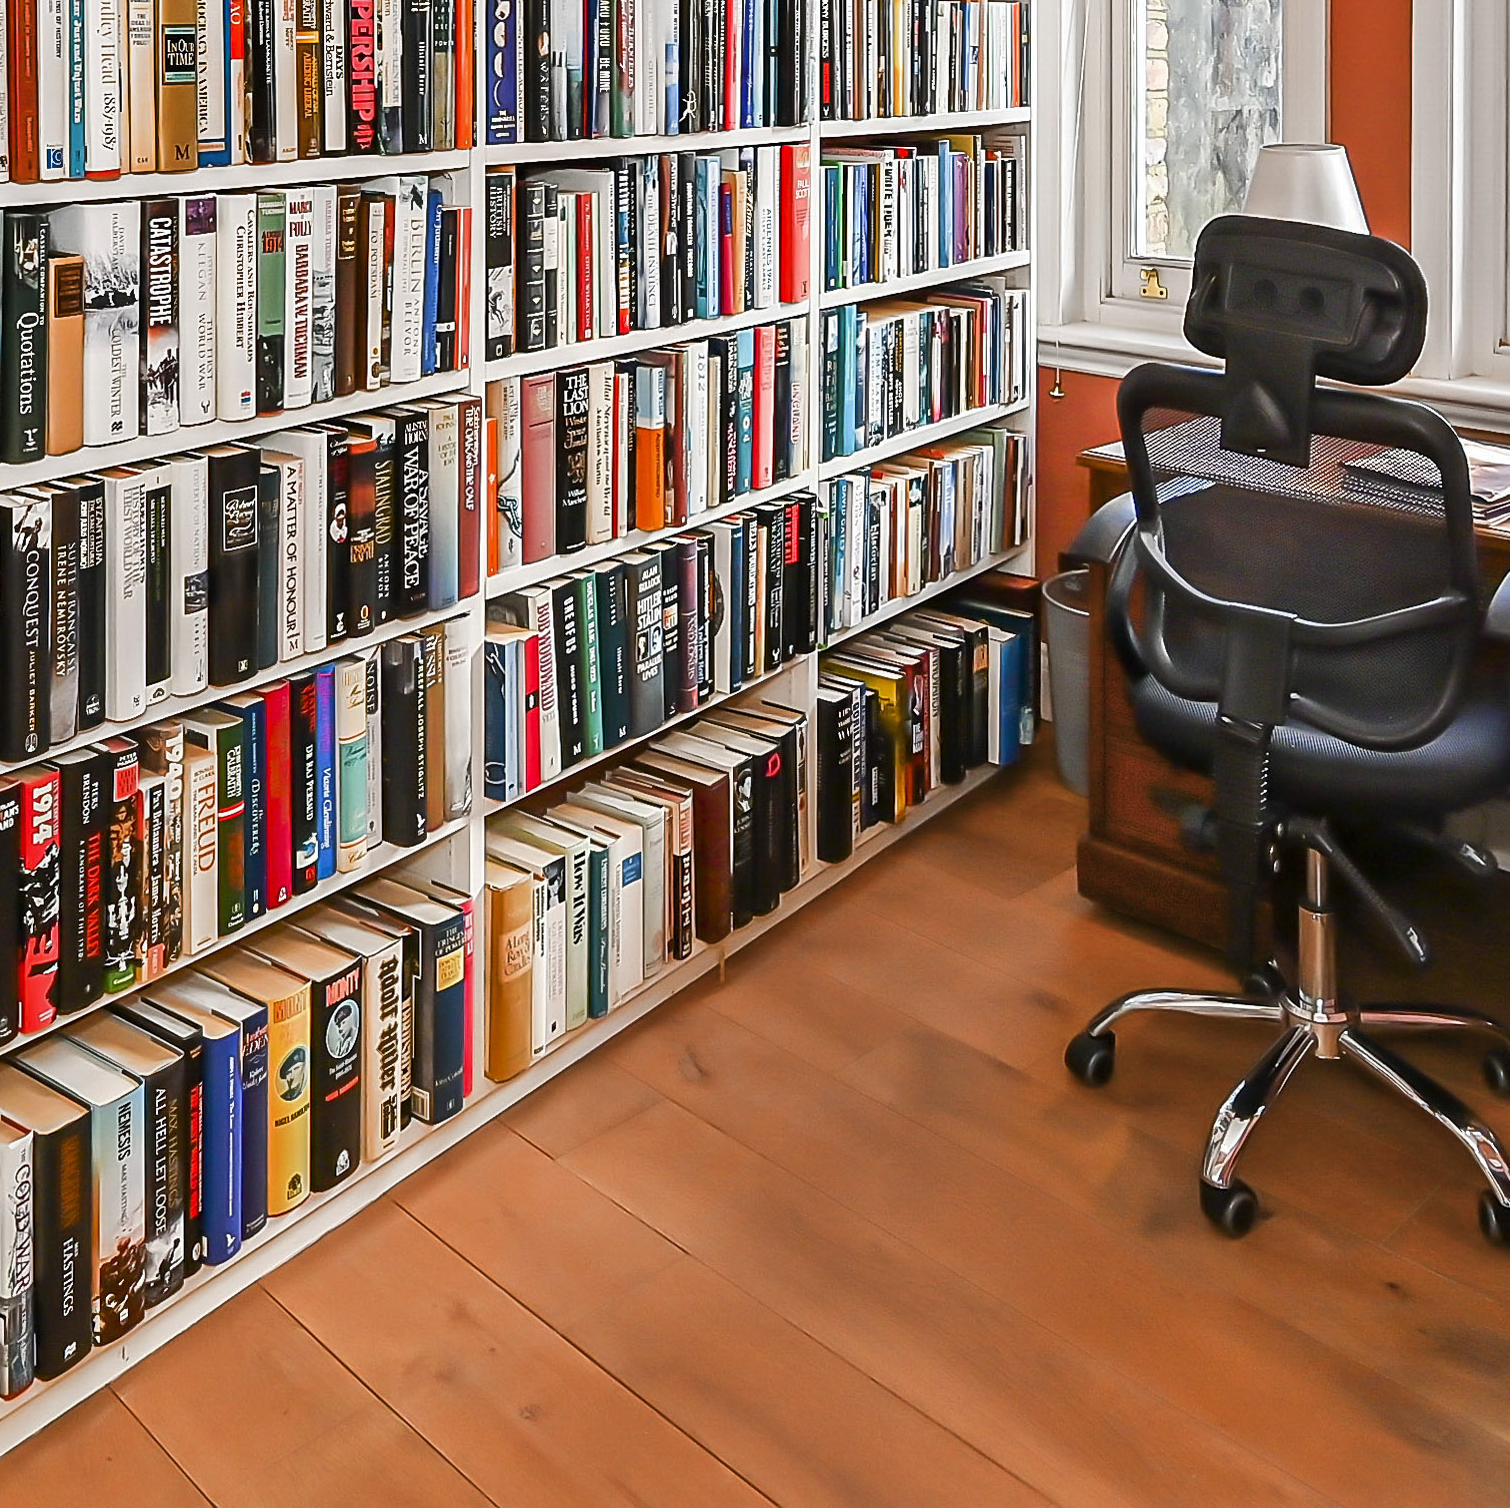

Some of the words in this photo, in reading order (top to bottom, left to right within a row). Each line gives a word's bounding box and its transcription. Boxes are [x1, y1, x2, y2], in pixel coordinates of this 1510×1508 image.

[149, 218, 172, 327] CATASTROPHE
[17, 313, 41, 416] Quotations
[563, 399, 588, 416] LION
[287, 467, 296, 477] A
[375, 460, 393, 544] STALINGRAD
[287, 481, 297, 540] MATTER
[286, 544, 297, 562] OF
[25, 550, 39, 647] CONQUEST
[286, 567, 297, 632] HONOUR
[32, 783, 53, 844] 1914
[198, 788, 216, 870] FREUD
[325, 969, 360, 1005] MONTY
[117, 1100, 131, 1161] NEMESIS
[156, 1089, 166, 1117] ALL
[156, 1120, 166, 1154] HELL
[156, 1158, 167, 1182] LET
[155, 1187, 167, 1235] LOOSE
[62, 1236, 75, 1316] HASTINGS
